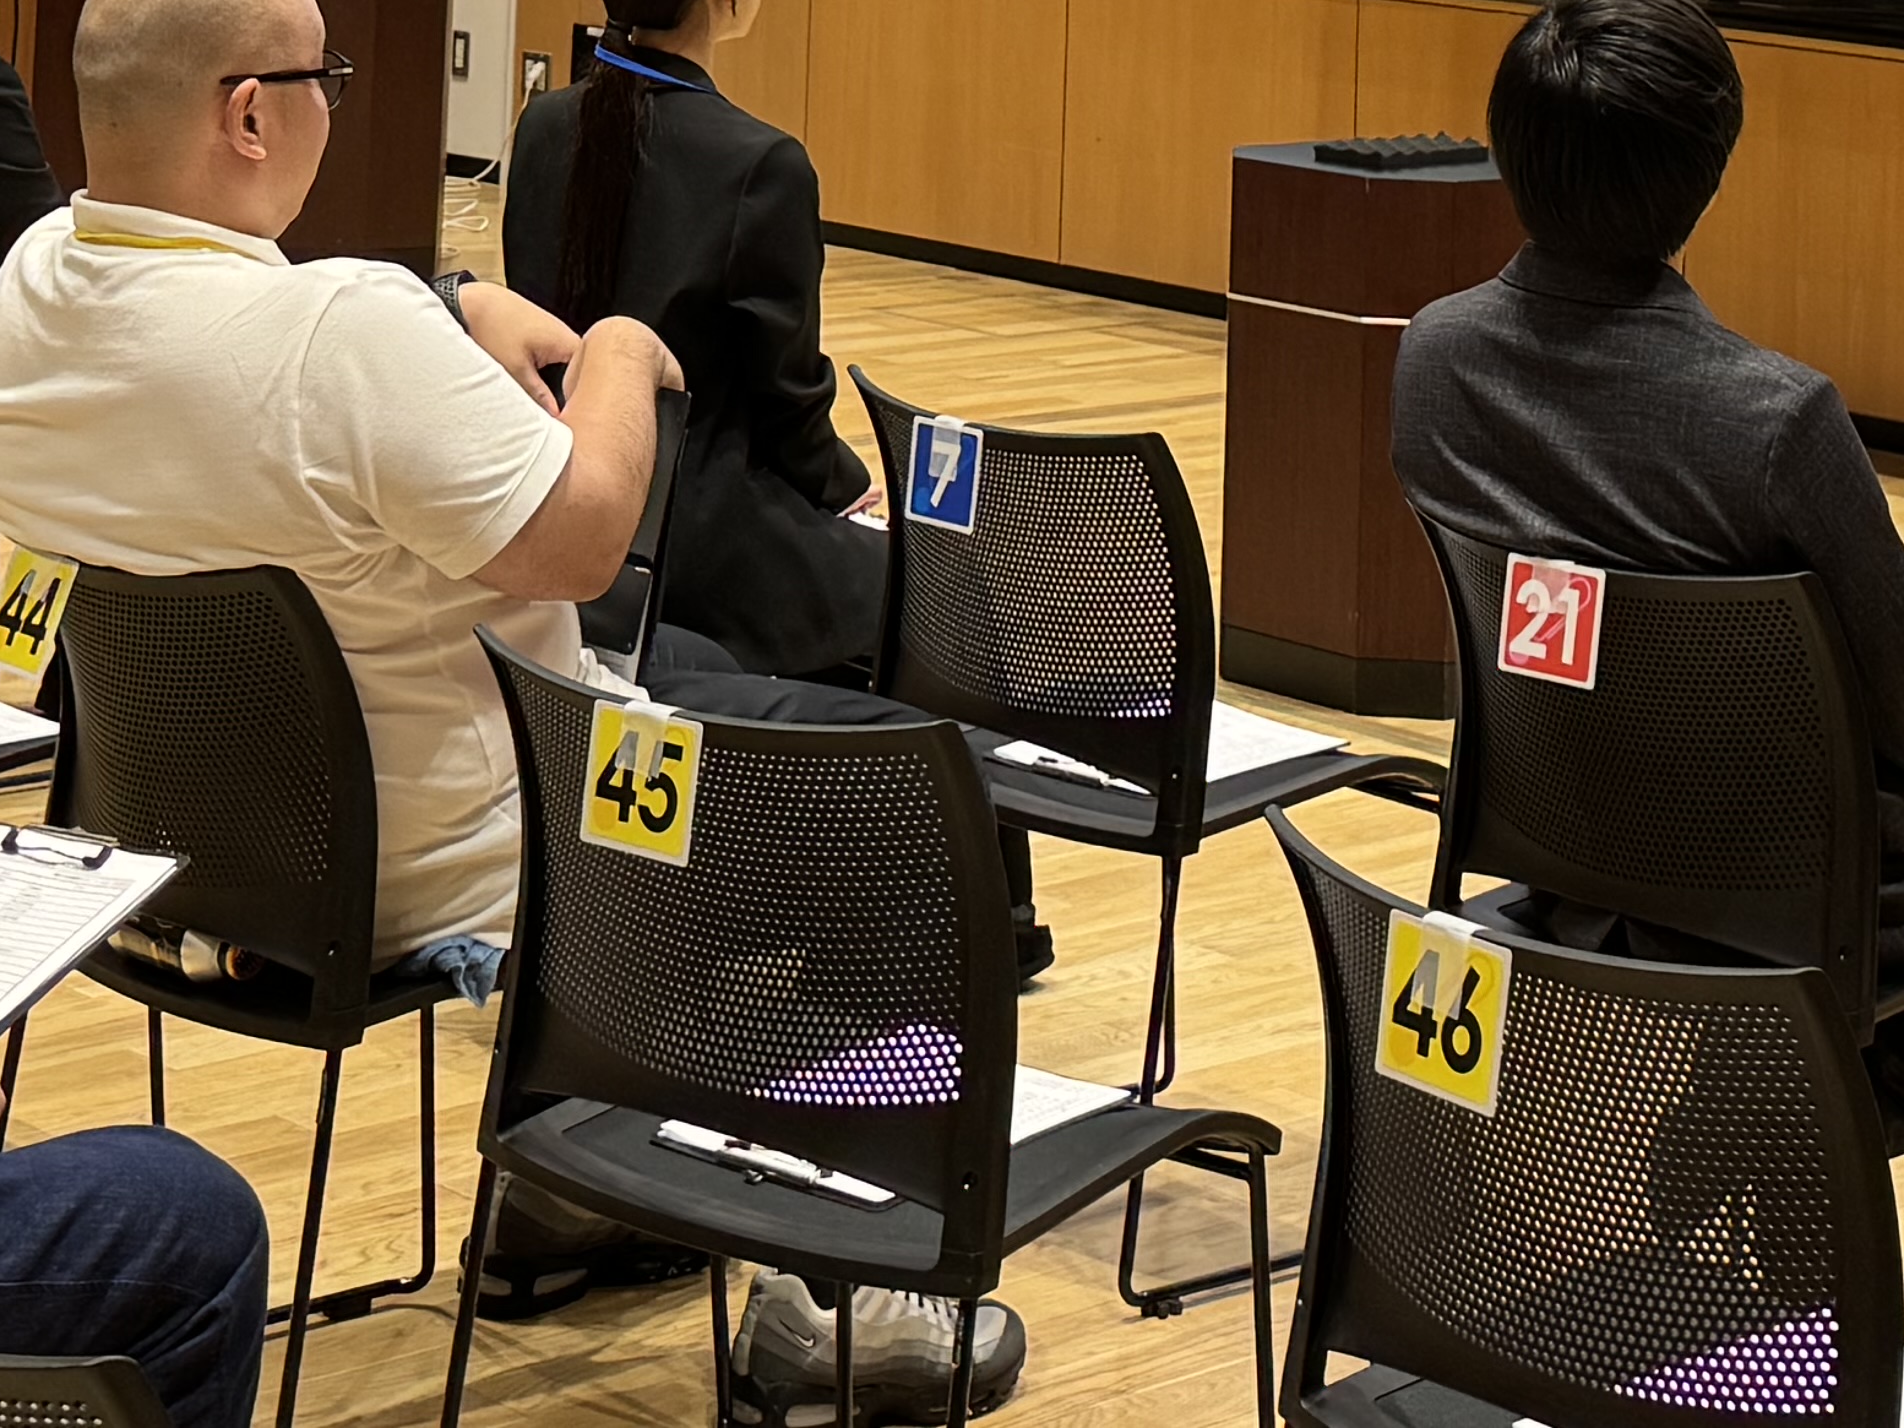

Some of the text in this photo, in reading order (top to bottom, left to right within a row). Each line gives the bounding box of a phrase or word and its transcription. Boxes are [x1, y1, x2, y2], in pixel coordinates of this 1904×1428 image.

[929, 441, 963, 508] 7
[1509, 578, 1578, 663] 21
[595, 729, 684, 834] 45
[1391, 949, 1483, 1074] 46
